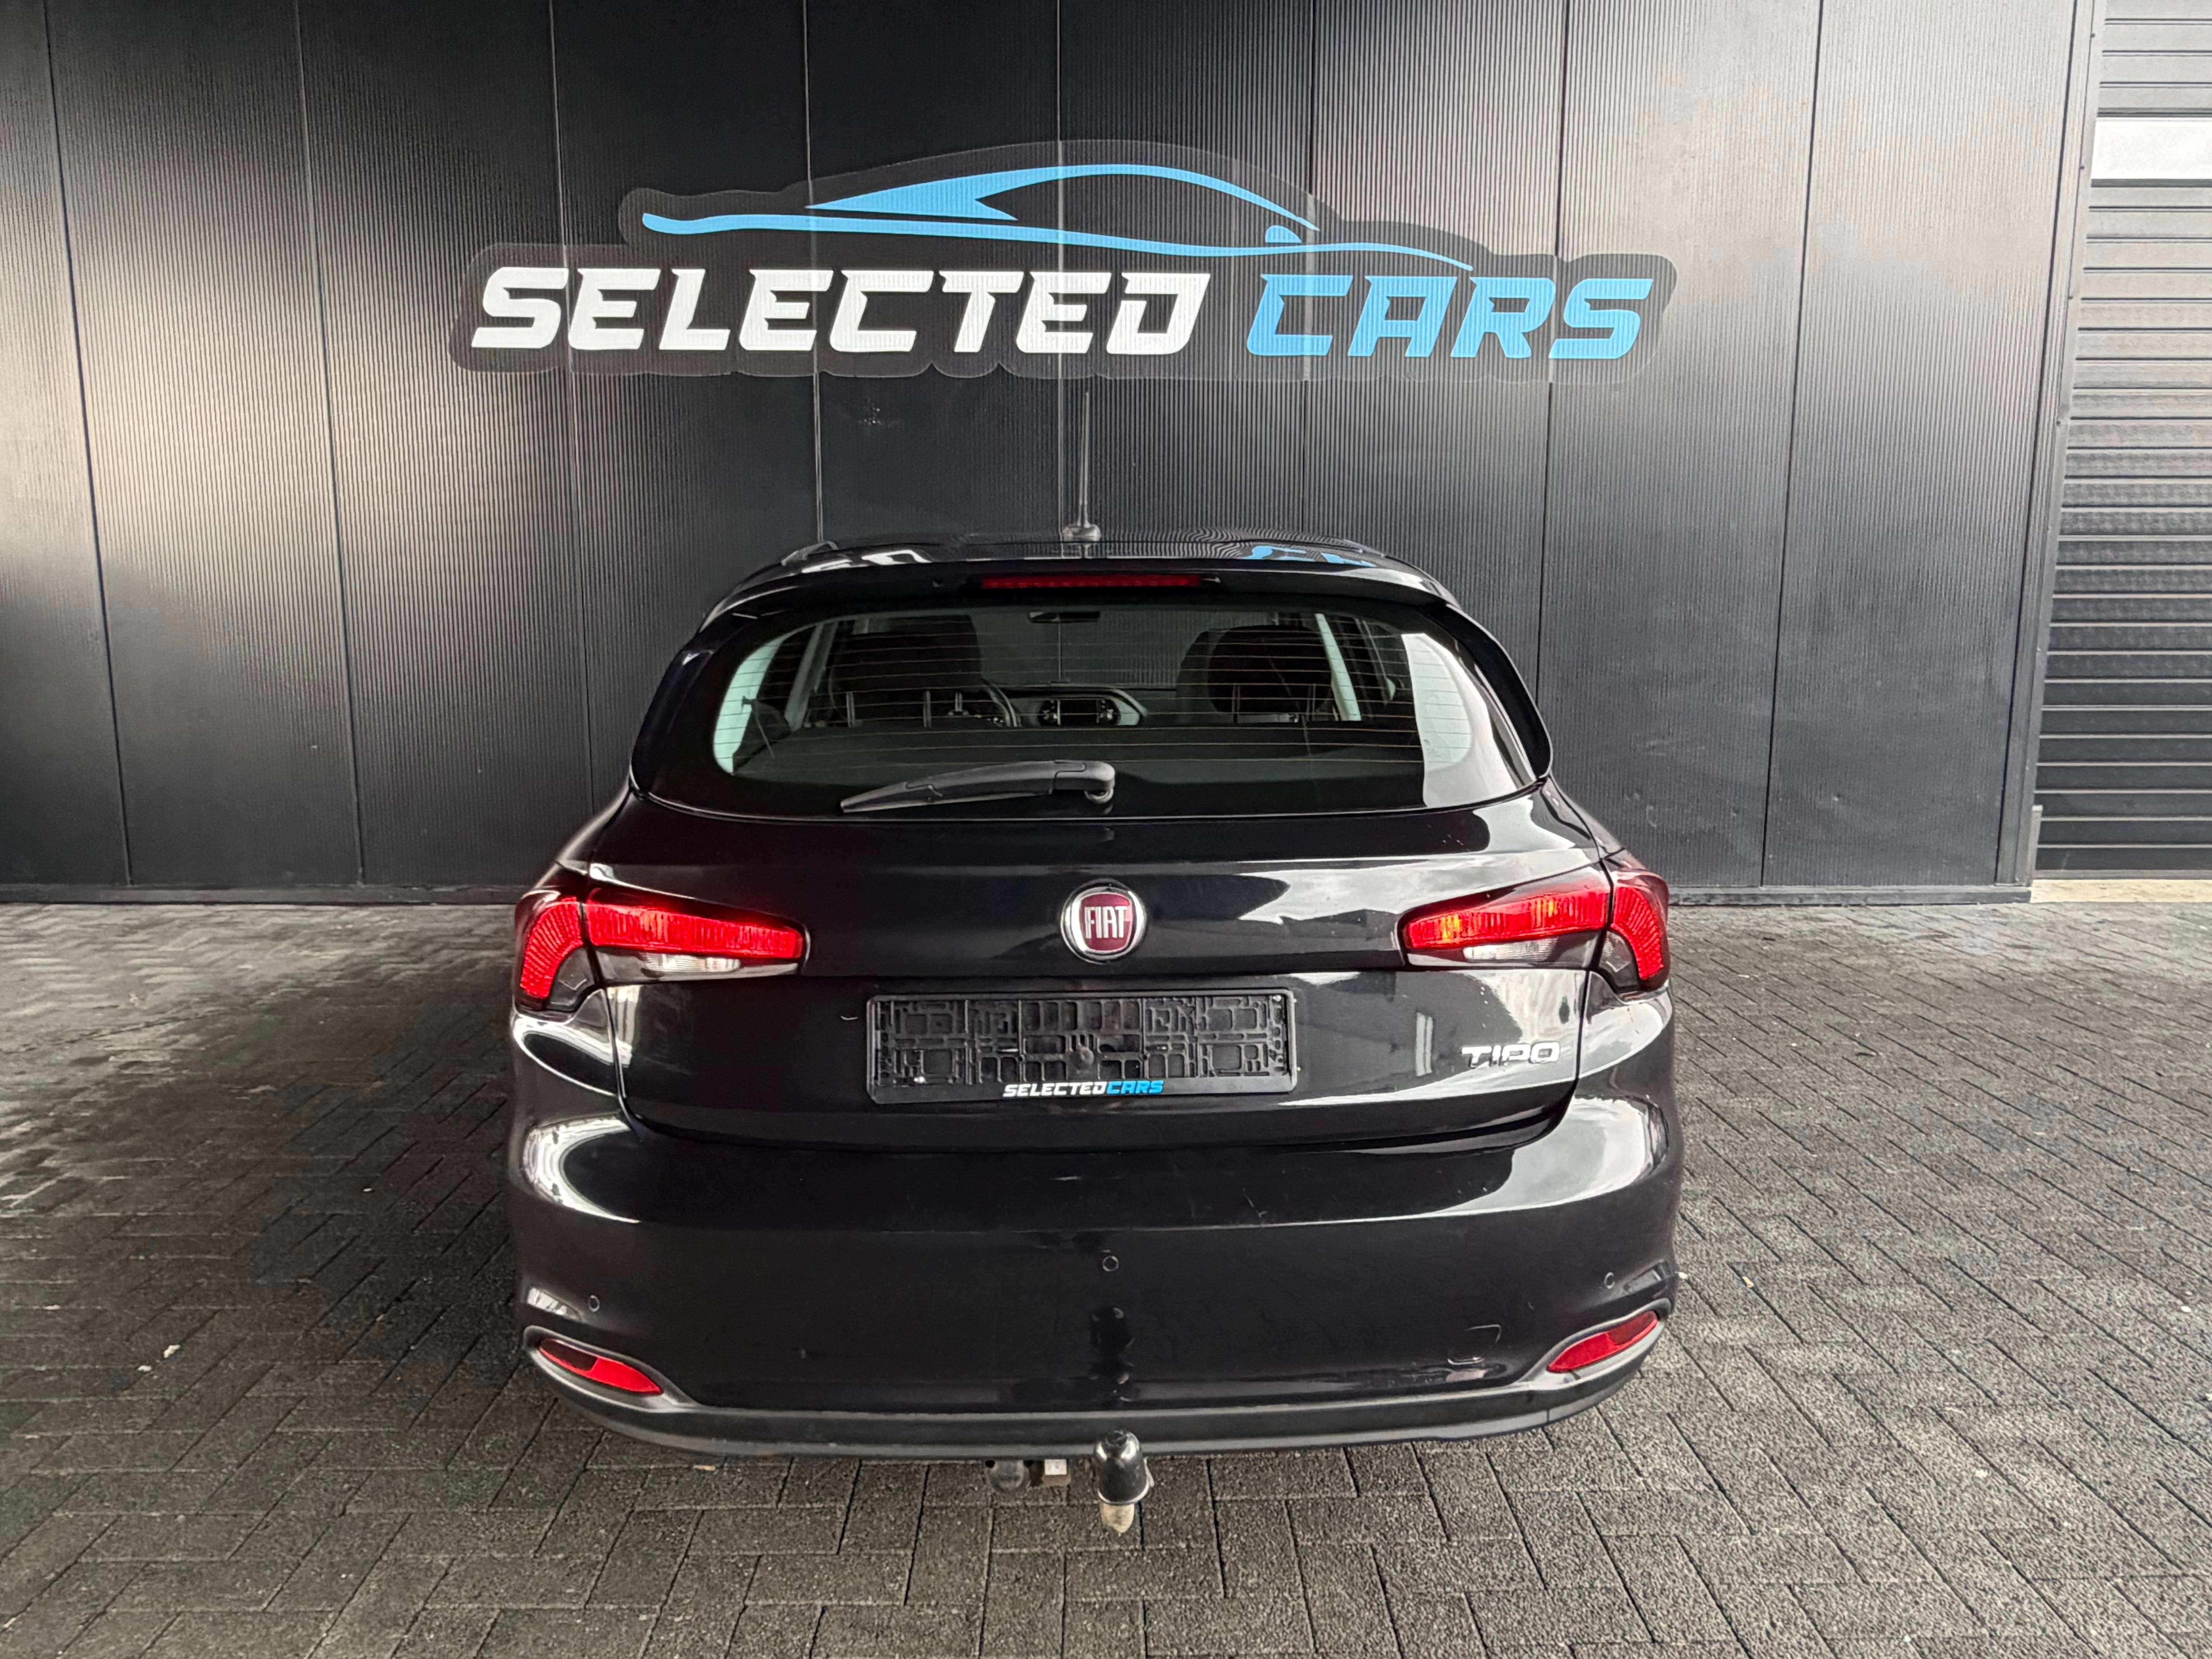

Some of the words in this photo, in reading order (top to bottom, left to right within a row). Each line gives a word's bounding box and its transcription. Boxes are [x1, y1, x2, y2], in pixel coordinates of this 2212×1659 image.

[471, 266, 1211, 354] SELECTED
[1247, 273, 1654, 359] CARS
[1085, 906, 1127, 938] FIAT
[1462, 1042, 1560, 1067] TIPO
